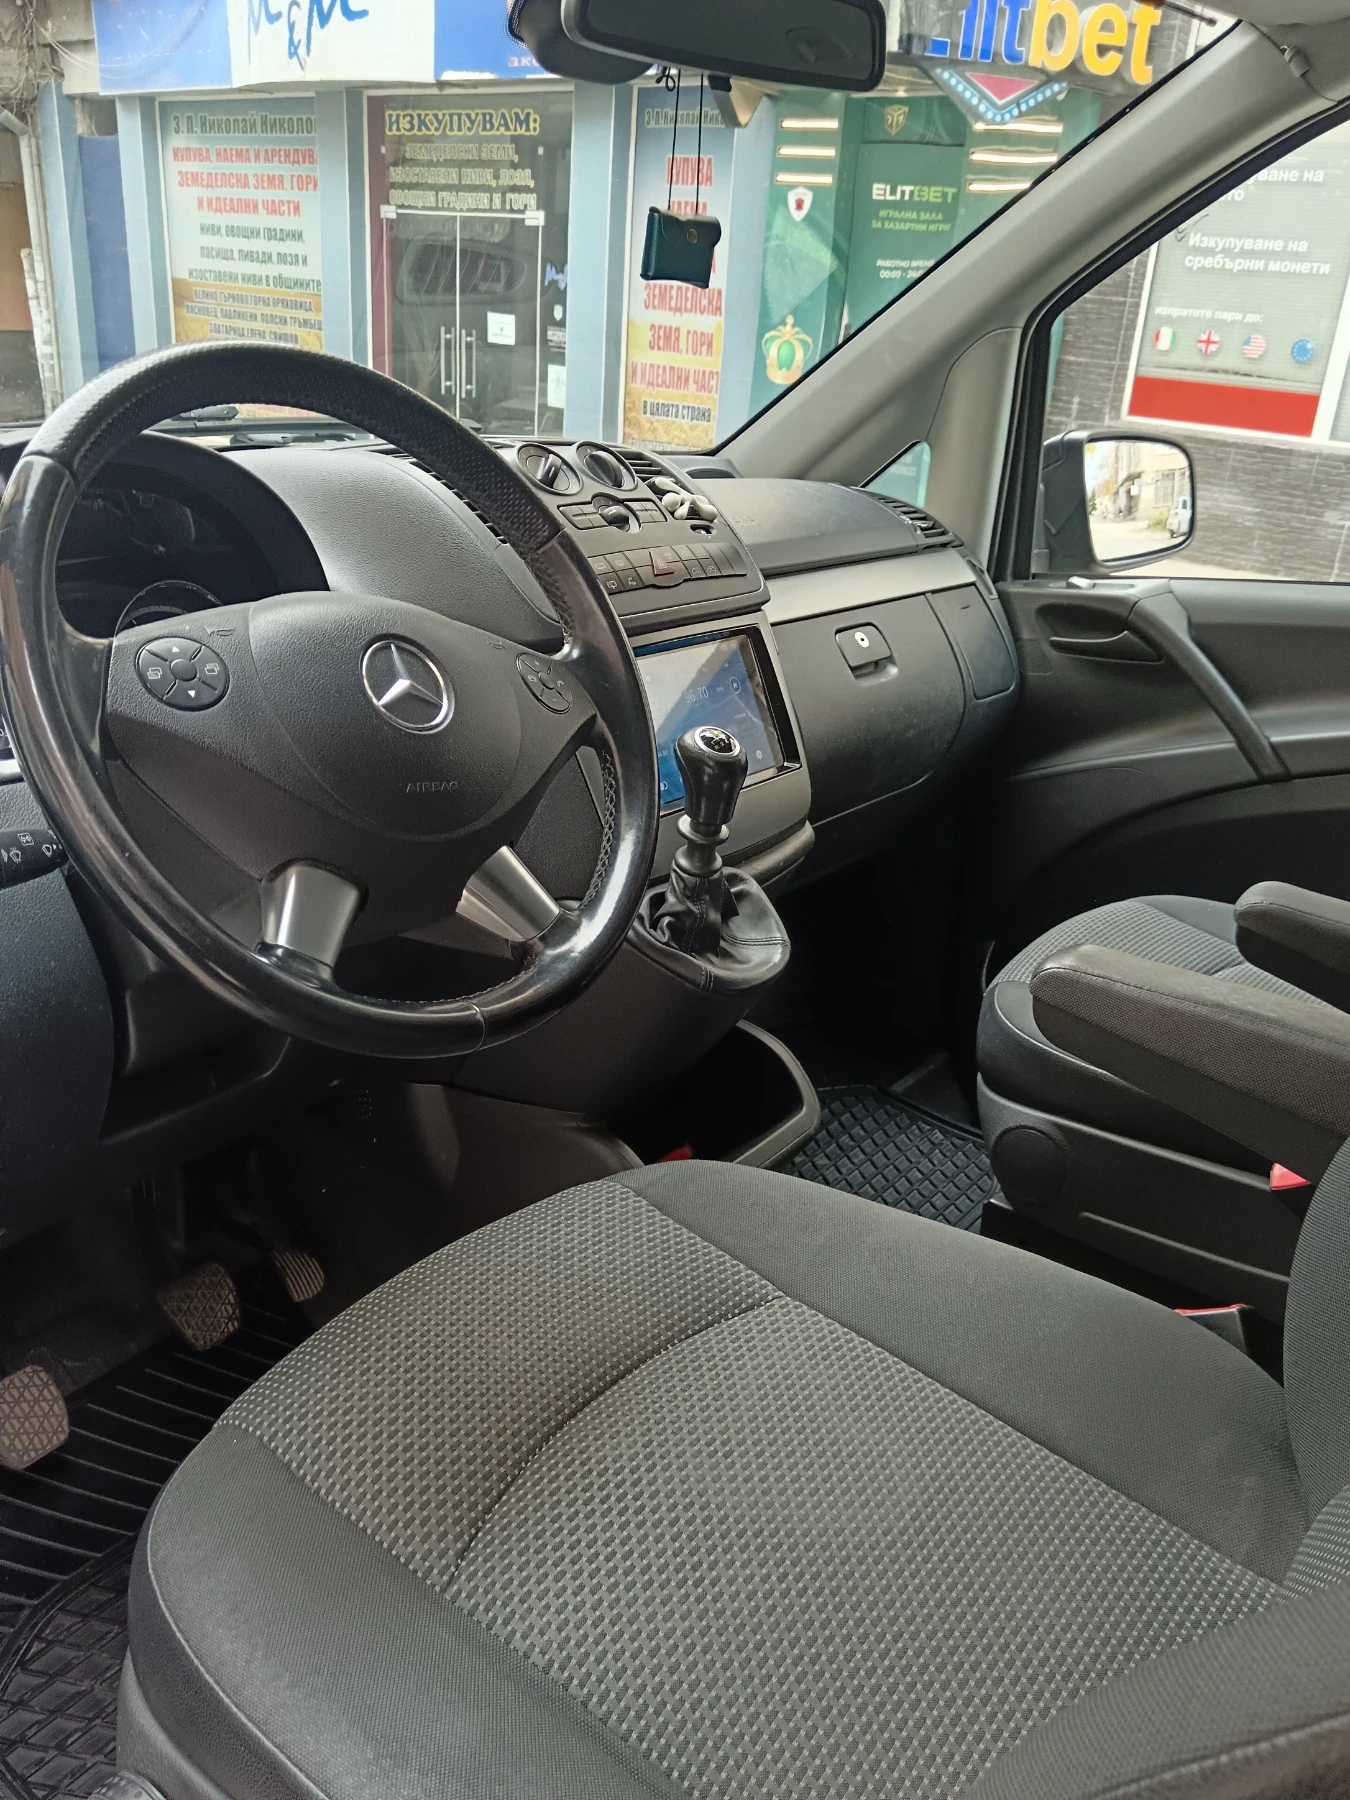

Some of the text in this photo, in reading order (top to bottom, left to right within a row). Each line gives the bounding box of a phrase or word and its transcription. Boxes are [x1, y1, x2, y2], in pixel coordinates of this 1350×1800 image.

[200, 112, 257, 134] Николай
[259, 113, 316, 134] Николо
[385, 109, 540, 135] ИЗКУПУВАМ:
[215, 147, 251, 163] НАЕМА
[254, 148, 261, 163] И
[177, 171, 250, 190] ЗЕМЕДЕЛСКА
[1302, 170, 1325, 182] на
[872, 183, 958, 204] ELITBET
[197, 196, 301, 217] И ИДЕАЛНИ ЧАСТИ
[1188, 232, 1309, 252] Изкупуване на
[1184, 253, 1331, 275] сребърни монети
[188, 268, 239, 283] изоставени
[644, 283, 722, 317] ЗЕМЕДЕЛСКА
[1213, 309, 1243, 322] пари
[685, 329, 714, 357] ГОРИ
[640, 363, 690, 391] ИДЕАЛНИ
[649, 402, 680, 419] цялата
[681, 404, 711, 423] страна
[406, 781, 459, 793] AIRBAG
